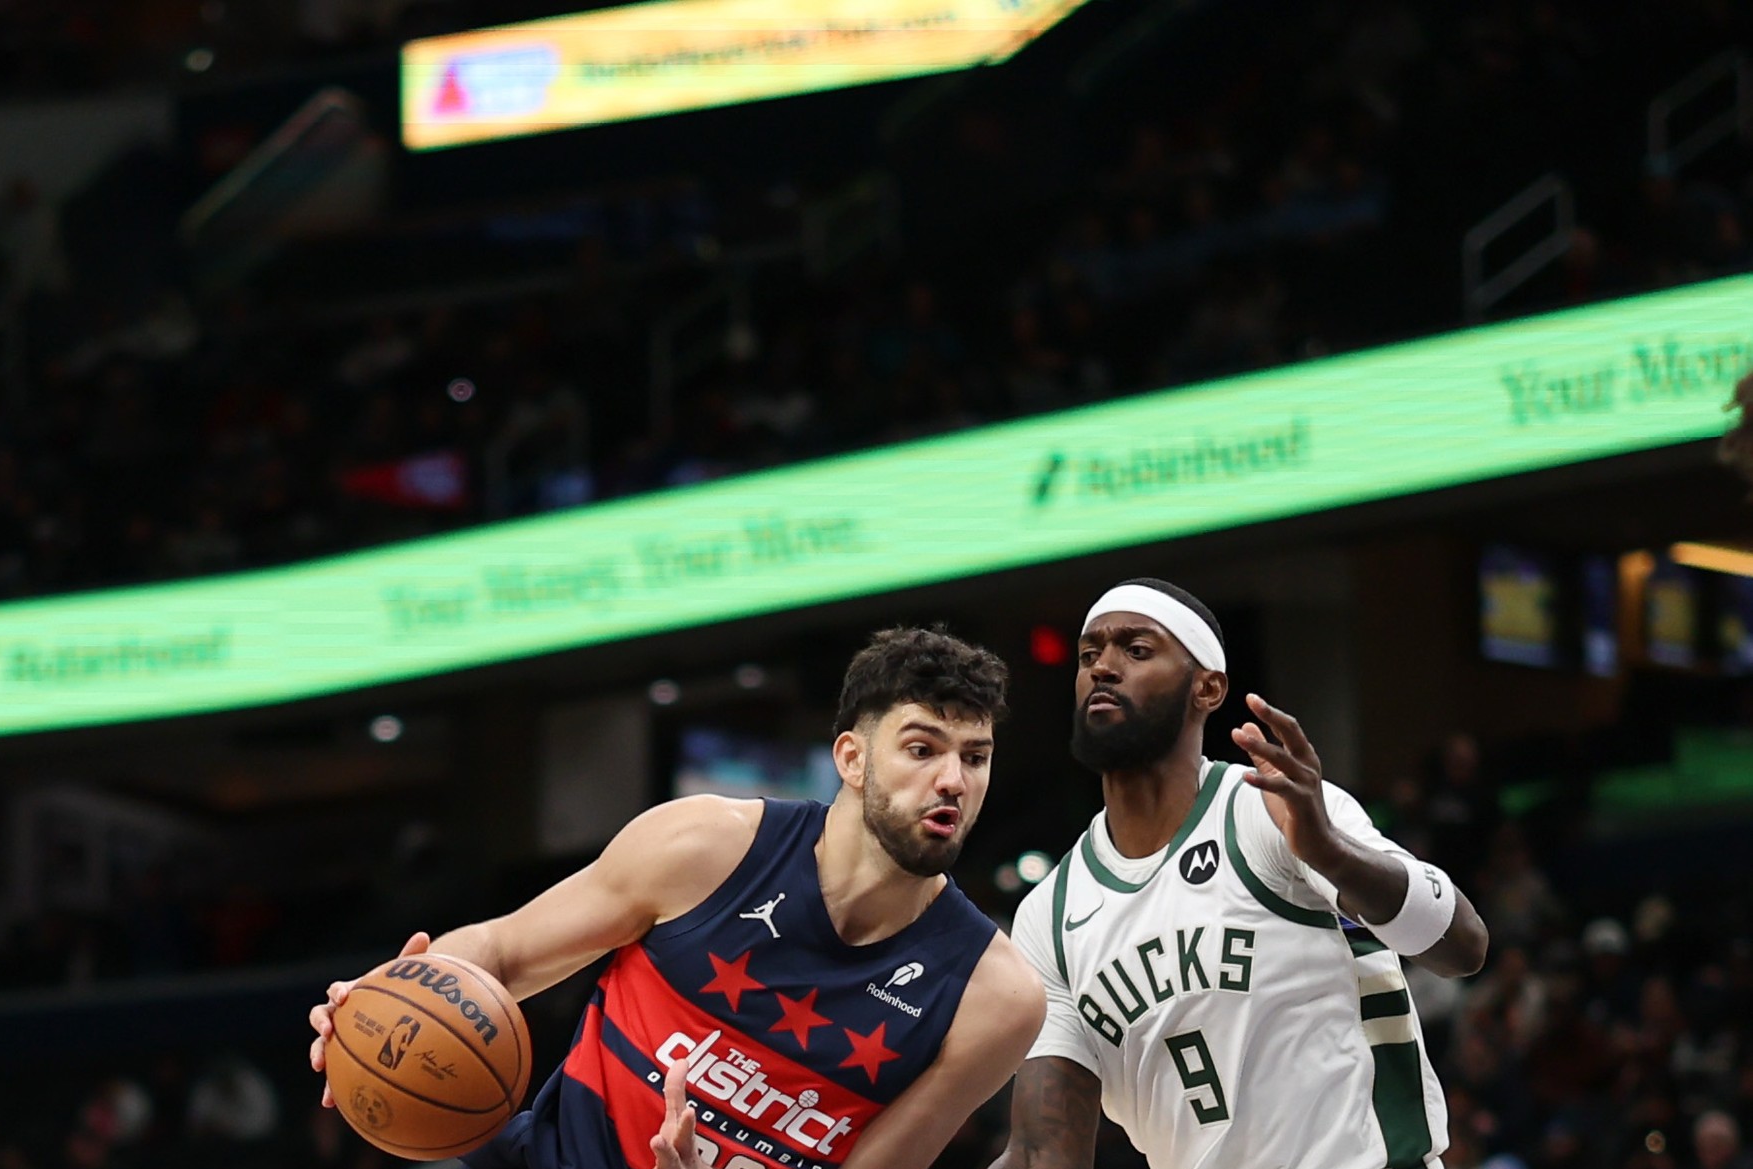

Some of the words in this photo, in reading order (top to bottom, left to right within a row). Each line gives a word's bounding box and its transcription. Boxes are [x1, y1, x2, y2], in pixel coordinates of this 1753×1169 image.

[385, 959, 498, 1048] Wilson
[866, 982, 923, 1018] Robinhood
[1077, 926, 1256, 1048] BUCKS
[726, 1047, 762, 1075] THE
[1164, 1029, 1230, 1125] 9
